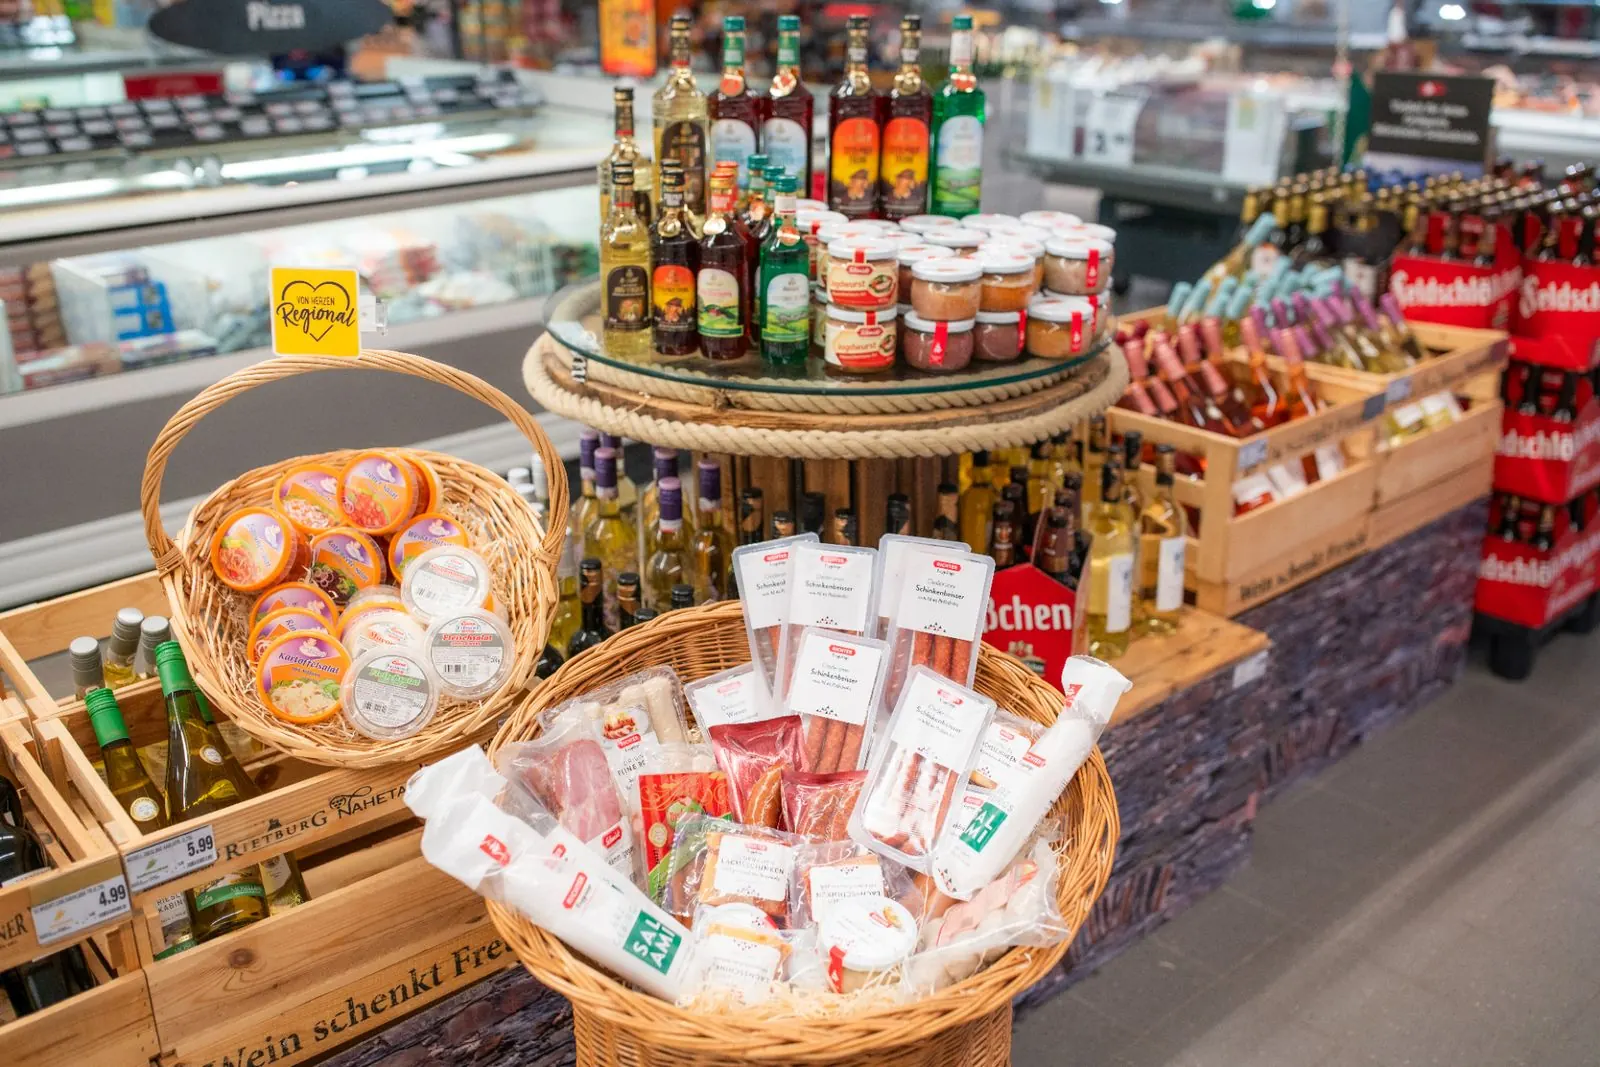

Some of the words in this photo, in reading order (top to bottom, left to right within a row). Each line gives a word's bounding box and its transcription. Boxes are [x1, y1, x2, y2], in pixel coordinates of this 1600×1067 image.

[297, 296, 309, 304] VON
[311, 297, 335, 306] HERZEN
[276, 303, 355, 334] Regional
[278, 652, 339, 675] Kartoffelsalat
[187, 834, 214, 857] 5.99
[98, 884, 126, 907] 4.99
[632, 918, 661, 958] SAL
[648, 925, 676, 969] AMI
[313, 962, 443, 1042] schenkt
